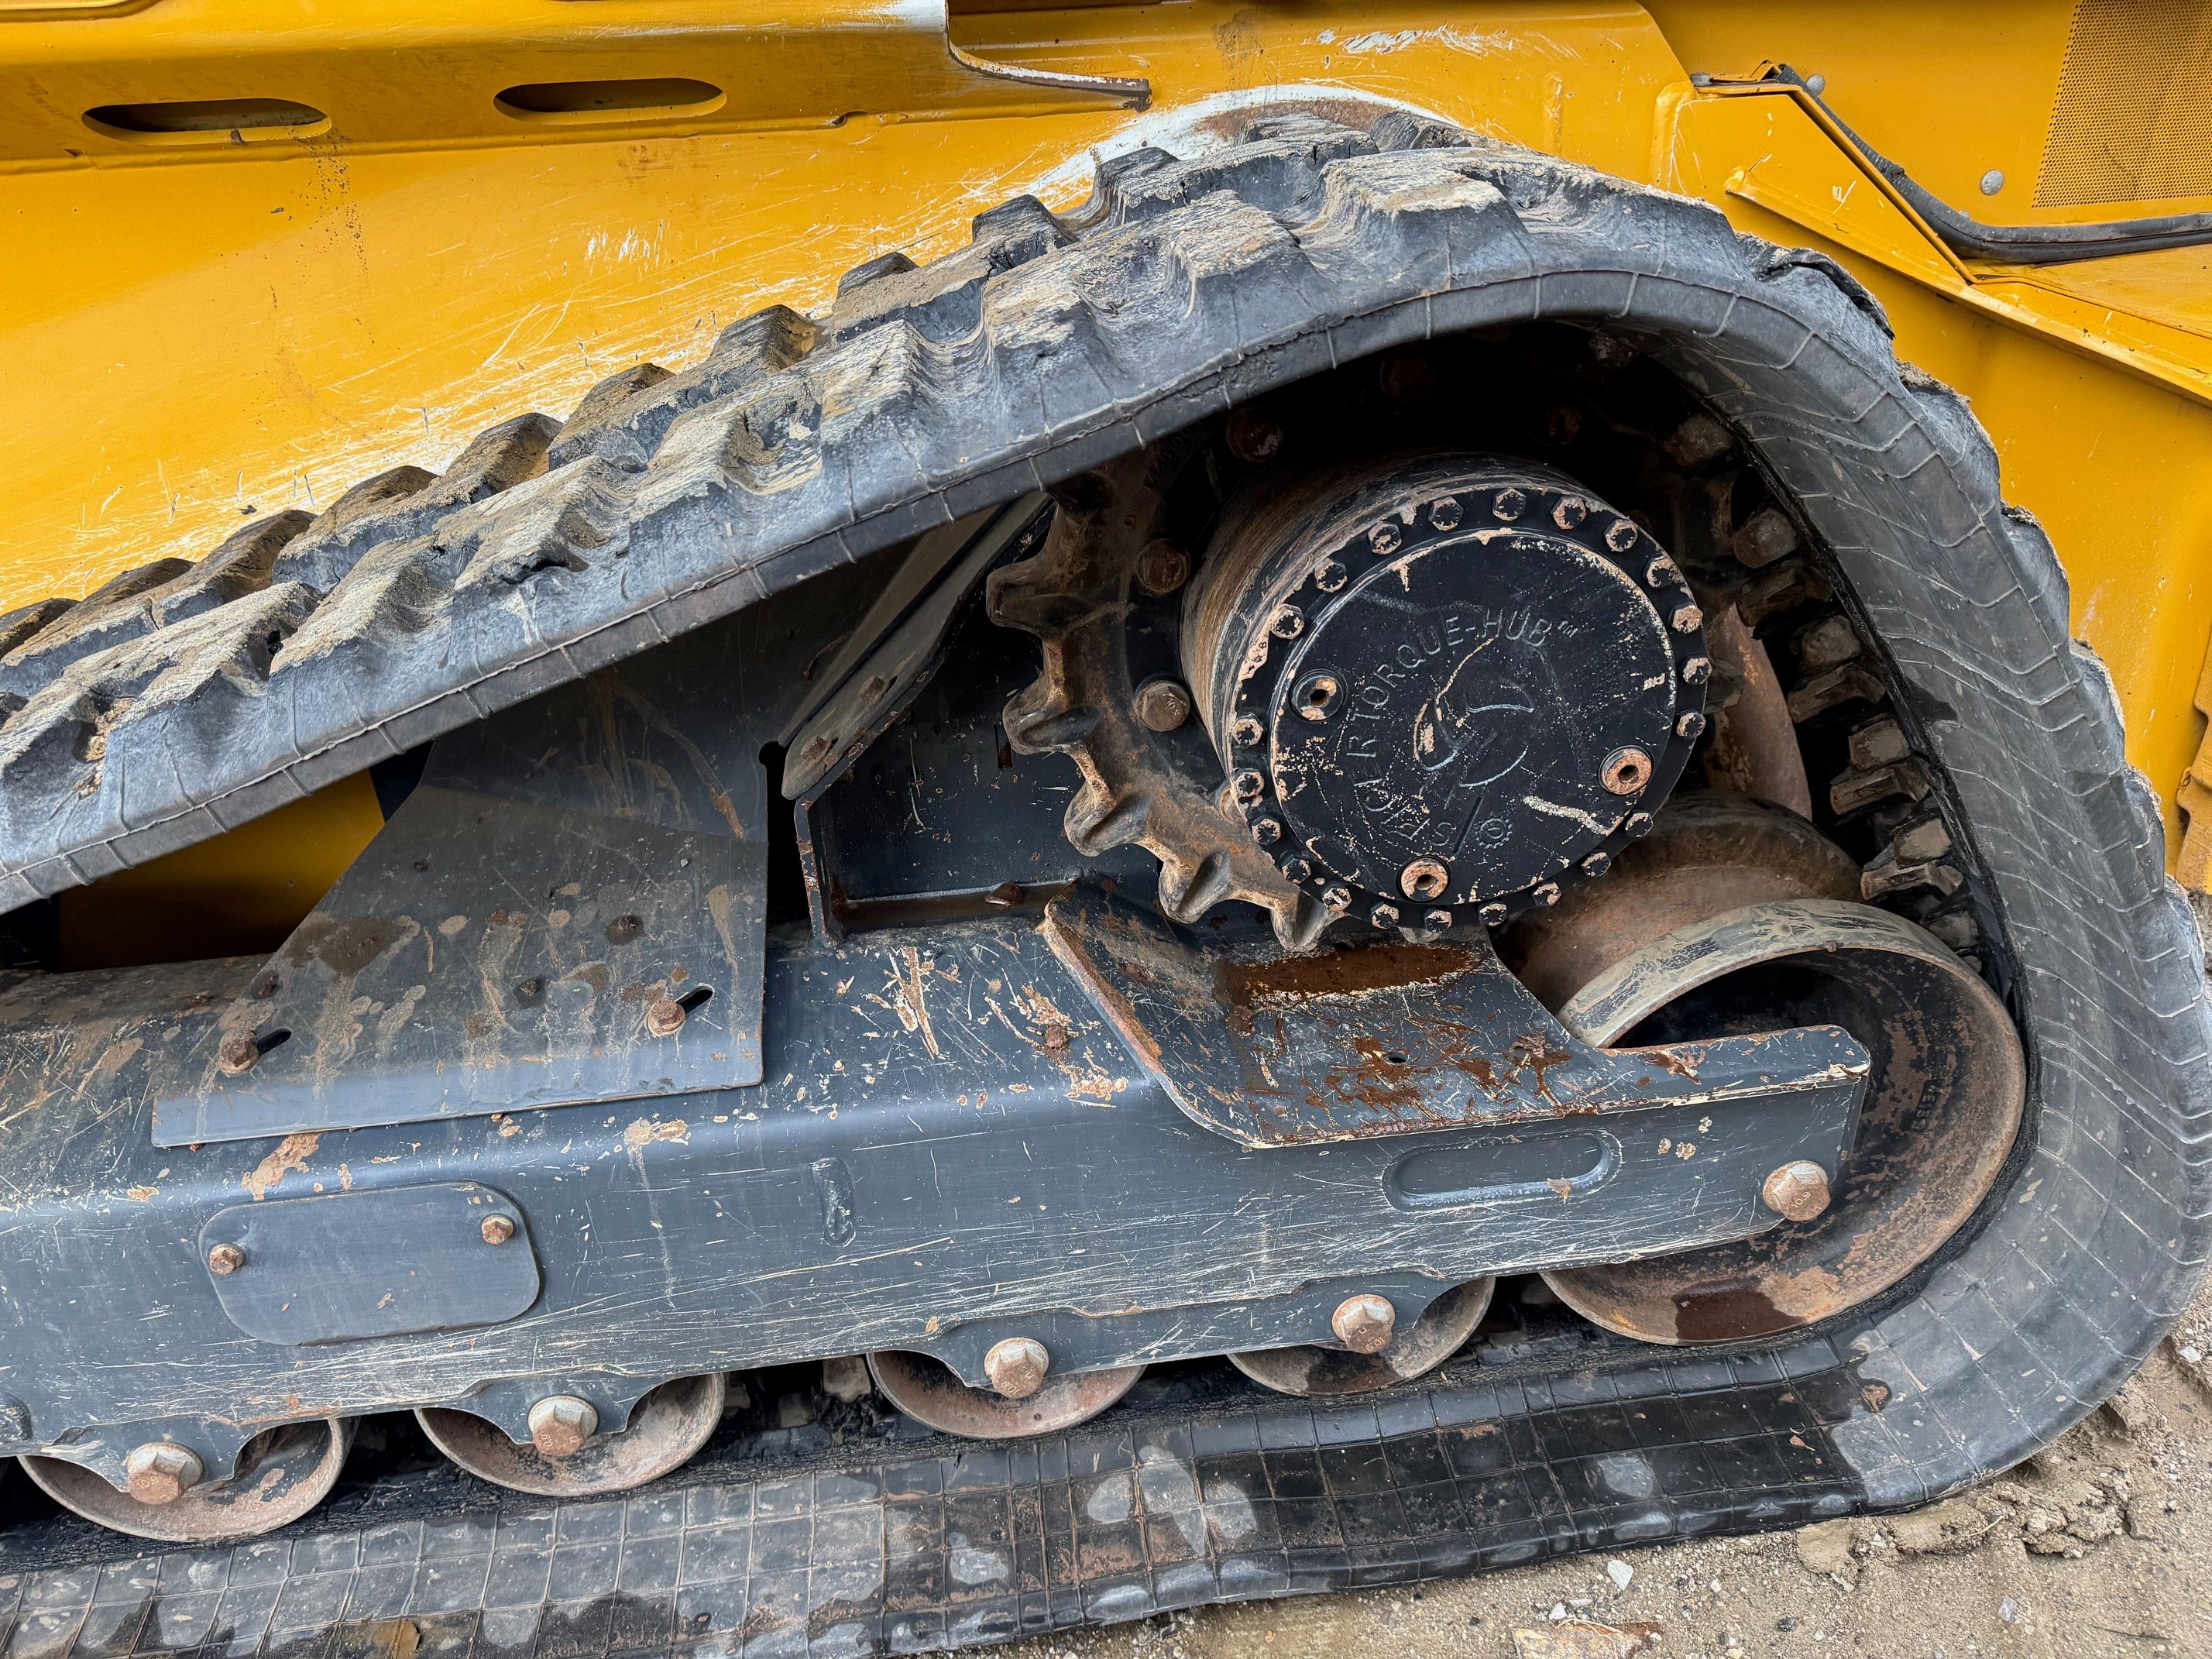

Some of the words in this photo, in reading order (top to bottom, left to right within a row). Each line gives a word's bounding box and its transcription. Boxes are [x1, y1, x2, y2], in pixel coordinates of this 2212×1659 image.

[1346, 736, 1456, 846] SPICER
[1791, 1191, 1811, 1207] 10.9
[136, 1476, 159, 1489] 10.9
